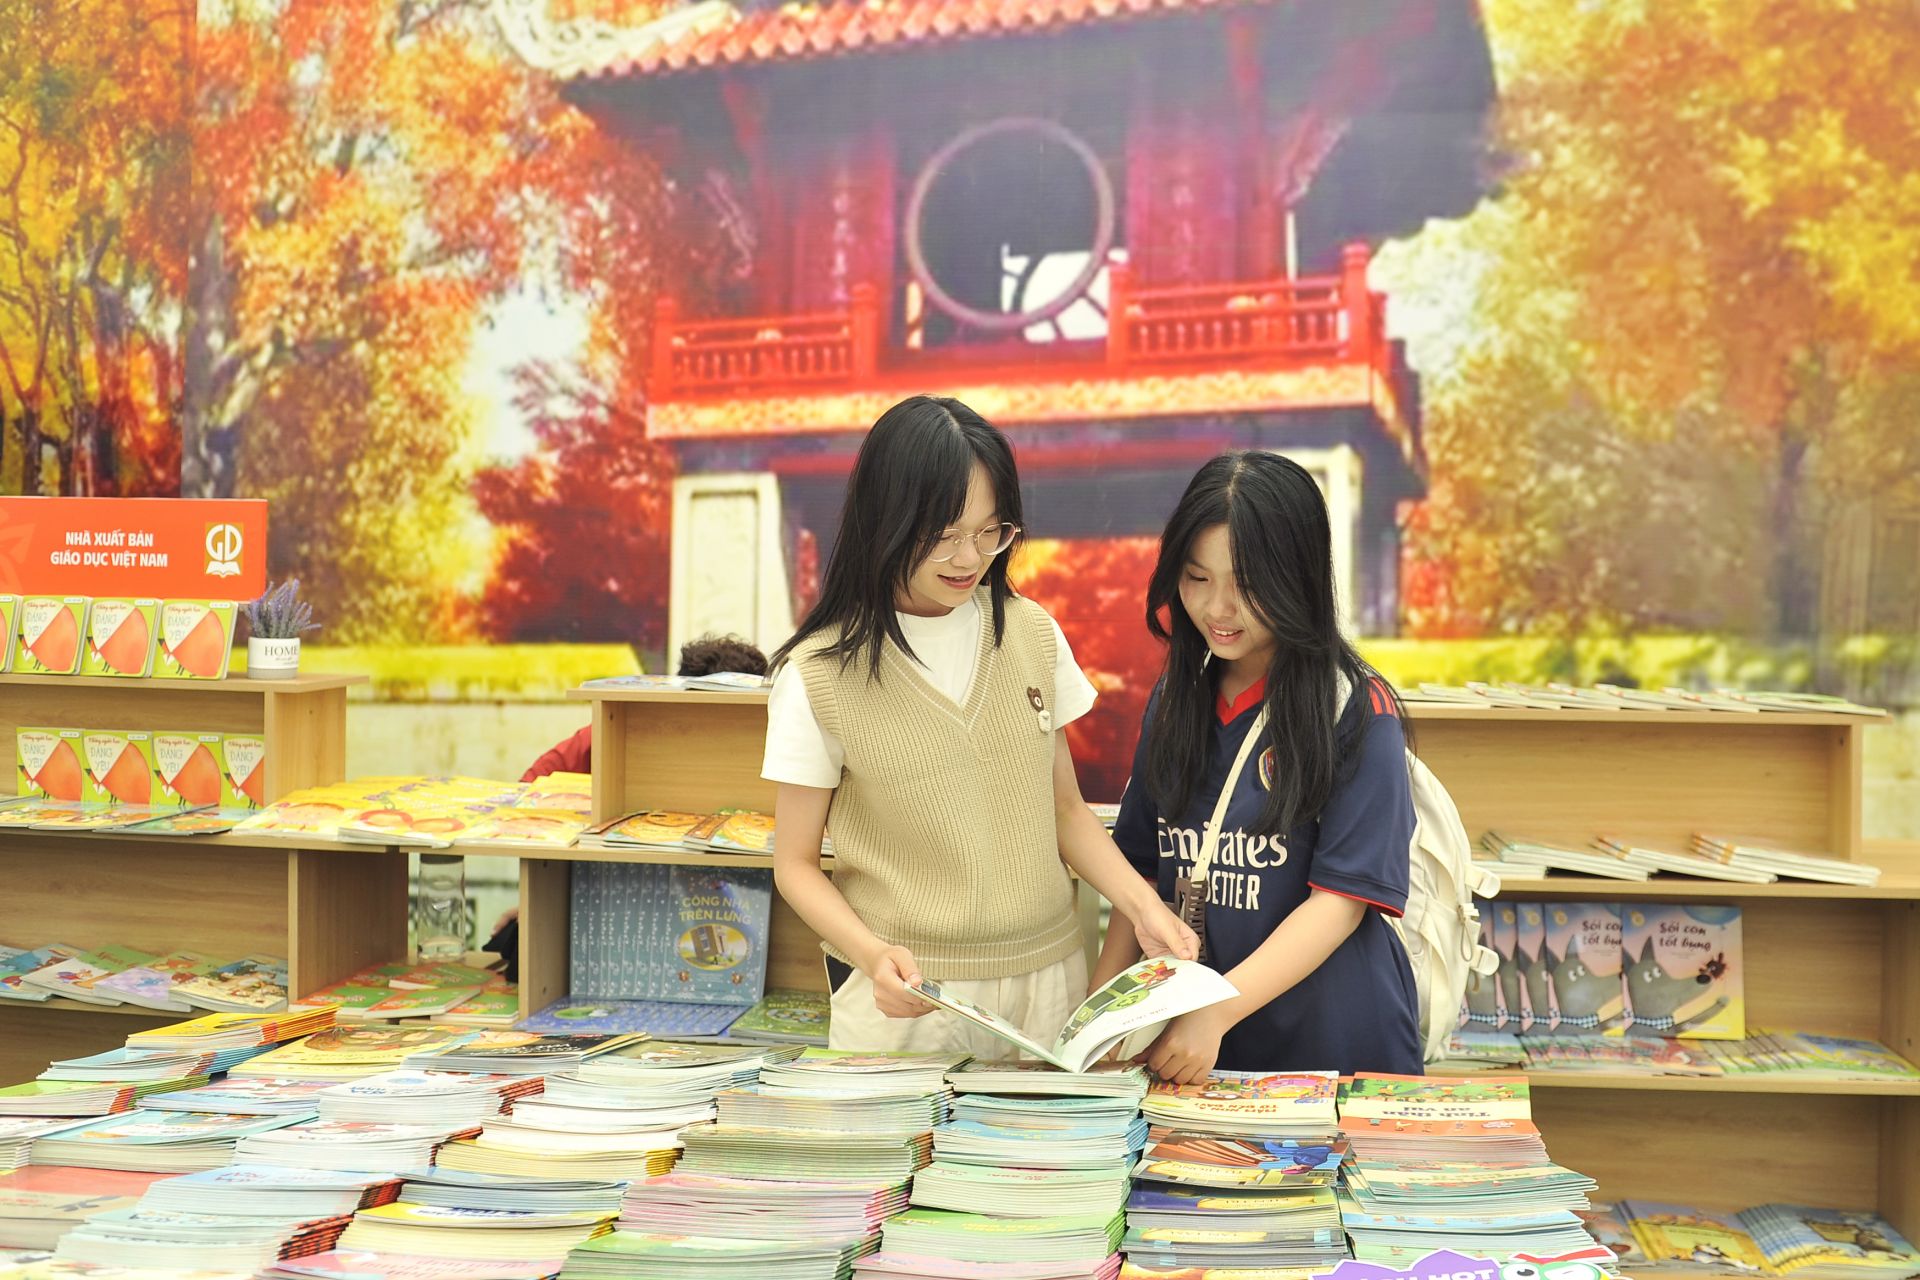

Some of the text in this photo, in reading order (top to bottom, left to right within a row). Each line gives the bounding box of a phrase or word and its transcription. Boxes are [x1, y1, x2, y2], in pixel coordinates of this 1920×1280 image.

[65, 529, 154, 547] NHÀ XUẤT BẢN
[50, 549, 168, 568] GIÁO DỤC VIỆT NAM
[679, 908, 713, 922] TRÊN
[1582, 919, 1601, 932] Sói
[1659, 921, 1706, 935] Sói con
